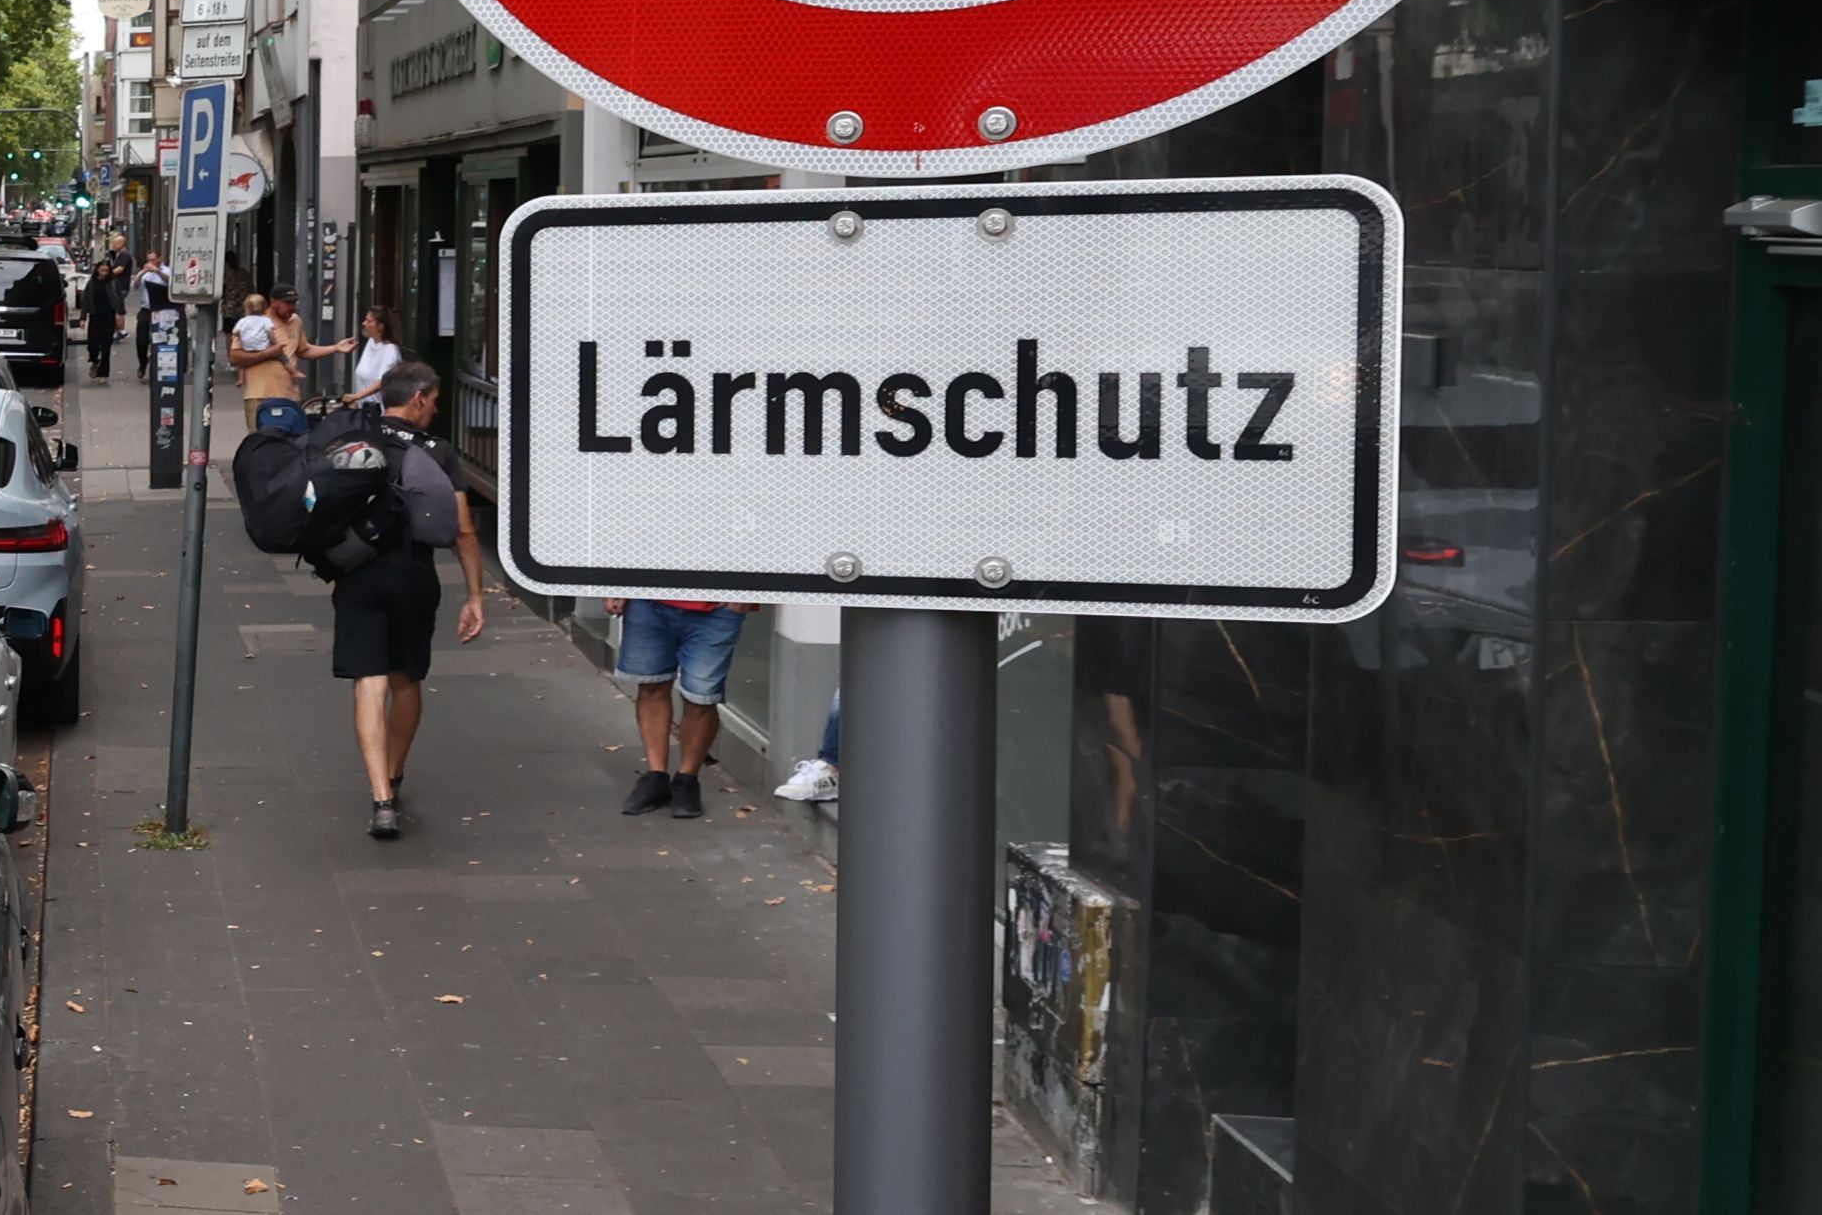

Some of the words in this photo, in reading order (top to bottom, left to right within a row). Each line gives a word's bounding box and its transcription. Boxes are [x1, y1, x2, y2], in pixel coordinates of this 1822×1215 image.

[197, 3, 204, 16] 6
[212, 2, 221, 15] 18
[196, 33, 210, 48] auf
[213, 32, 231, 47] dem
[185, 52, 241, 69] Seitenstreifen
[187, 97, 215, 190] P
[196, 223, 209, 237] mit
[577, 338, 1297, 462] Lärmschutz
